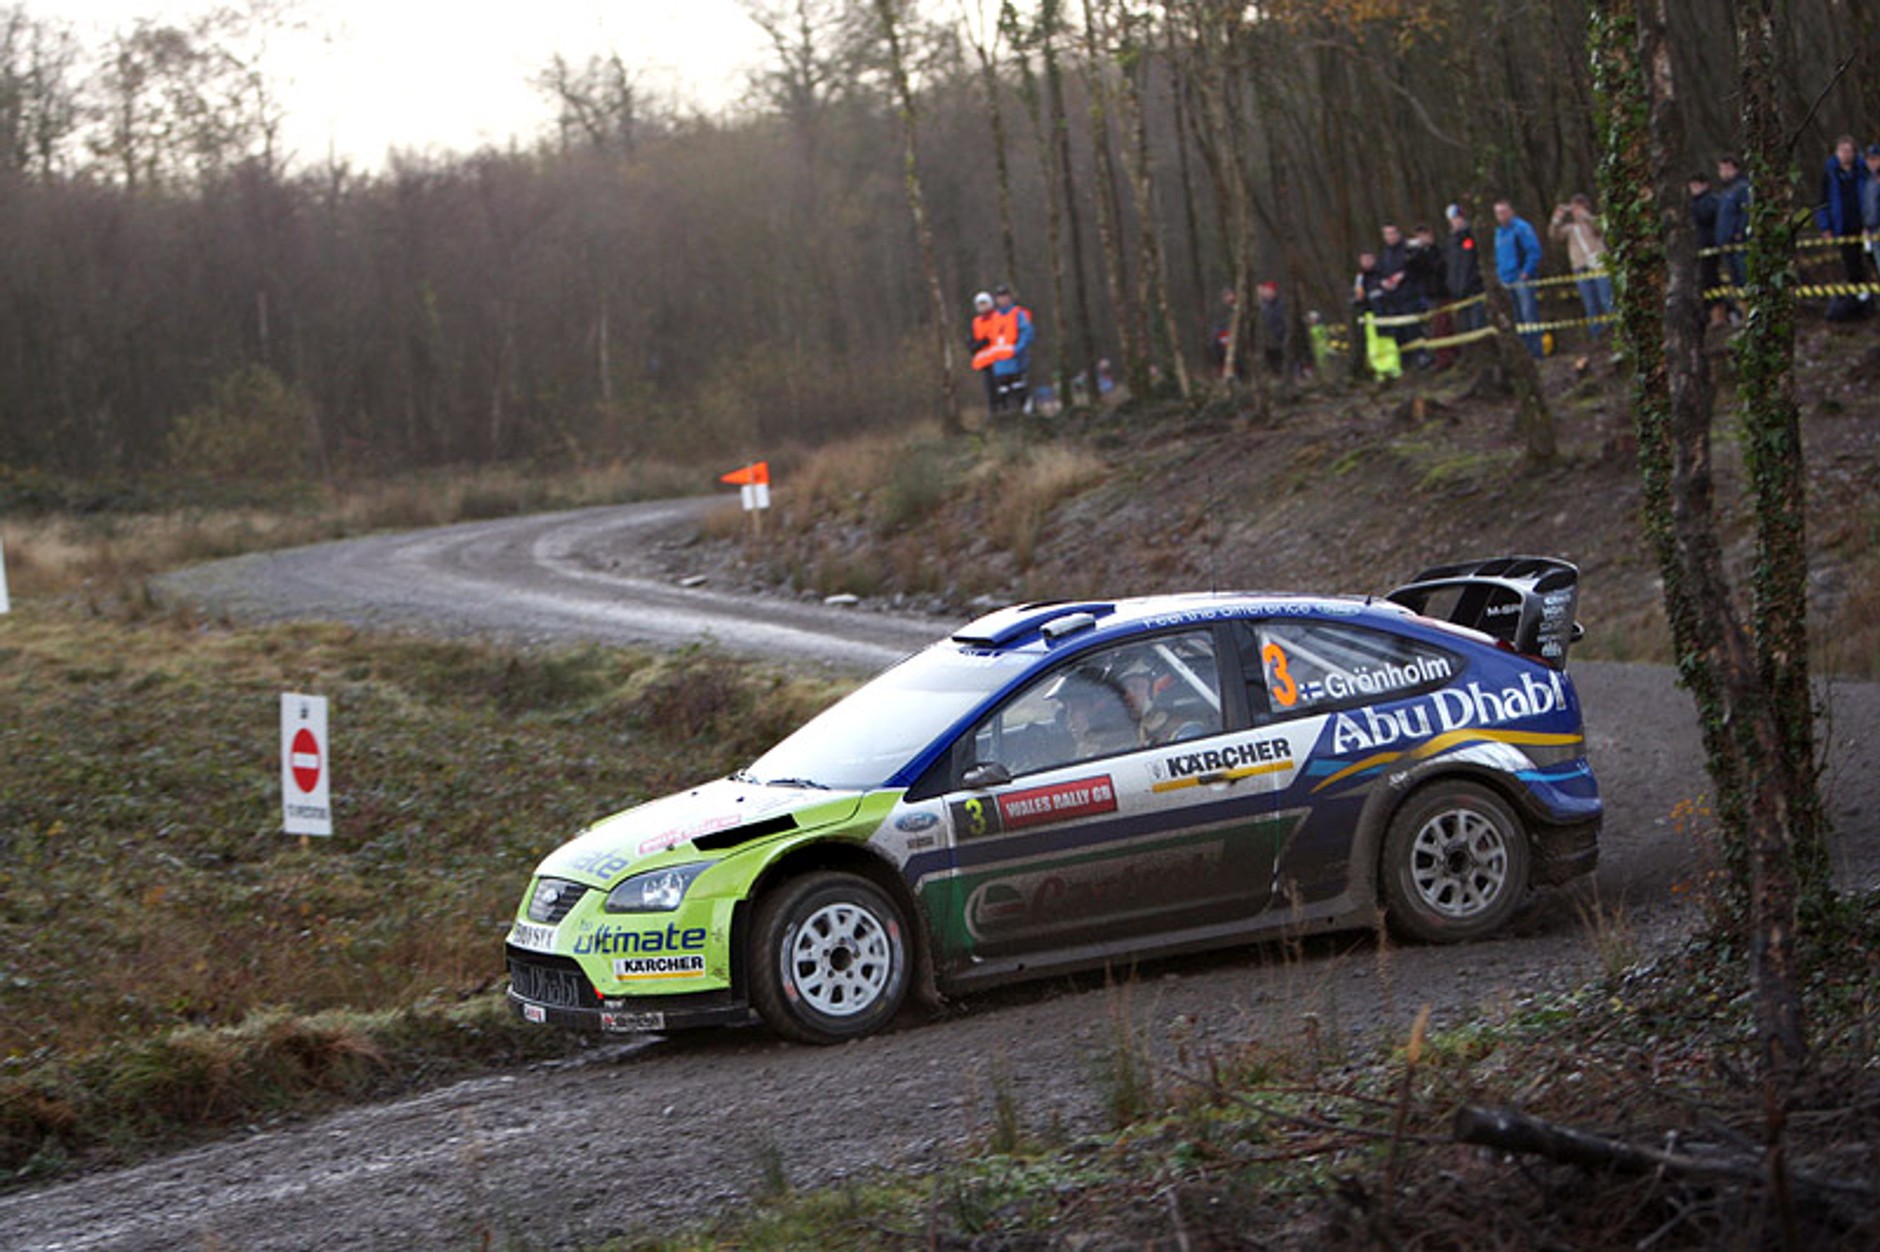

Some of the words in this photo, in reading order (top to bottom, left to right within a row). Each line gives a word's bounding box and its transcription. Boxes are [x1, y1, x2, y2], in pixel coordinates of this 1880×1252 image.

[1262, 643, 1297, 706] 3
[1325, 656, 1451, 698] Grönholm
[1334, 705, 1433, 754] Abu
[1429, 670, 1567, 731] Dhabi
[1166, 738, 1292, 777] KÄRCHER
[965, 798, 987, 836] 3
[1006, 796, 1052, 817] WALES
[1054, 790, 1090, 810] RALLY
[1092, 784, 1112, 803] GB
[573, 922, 707, 954] ultimate
